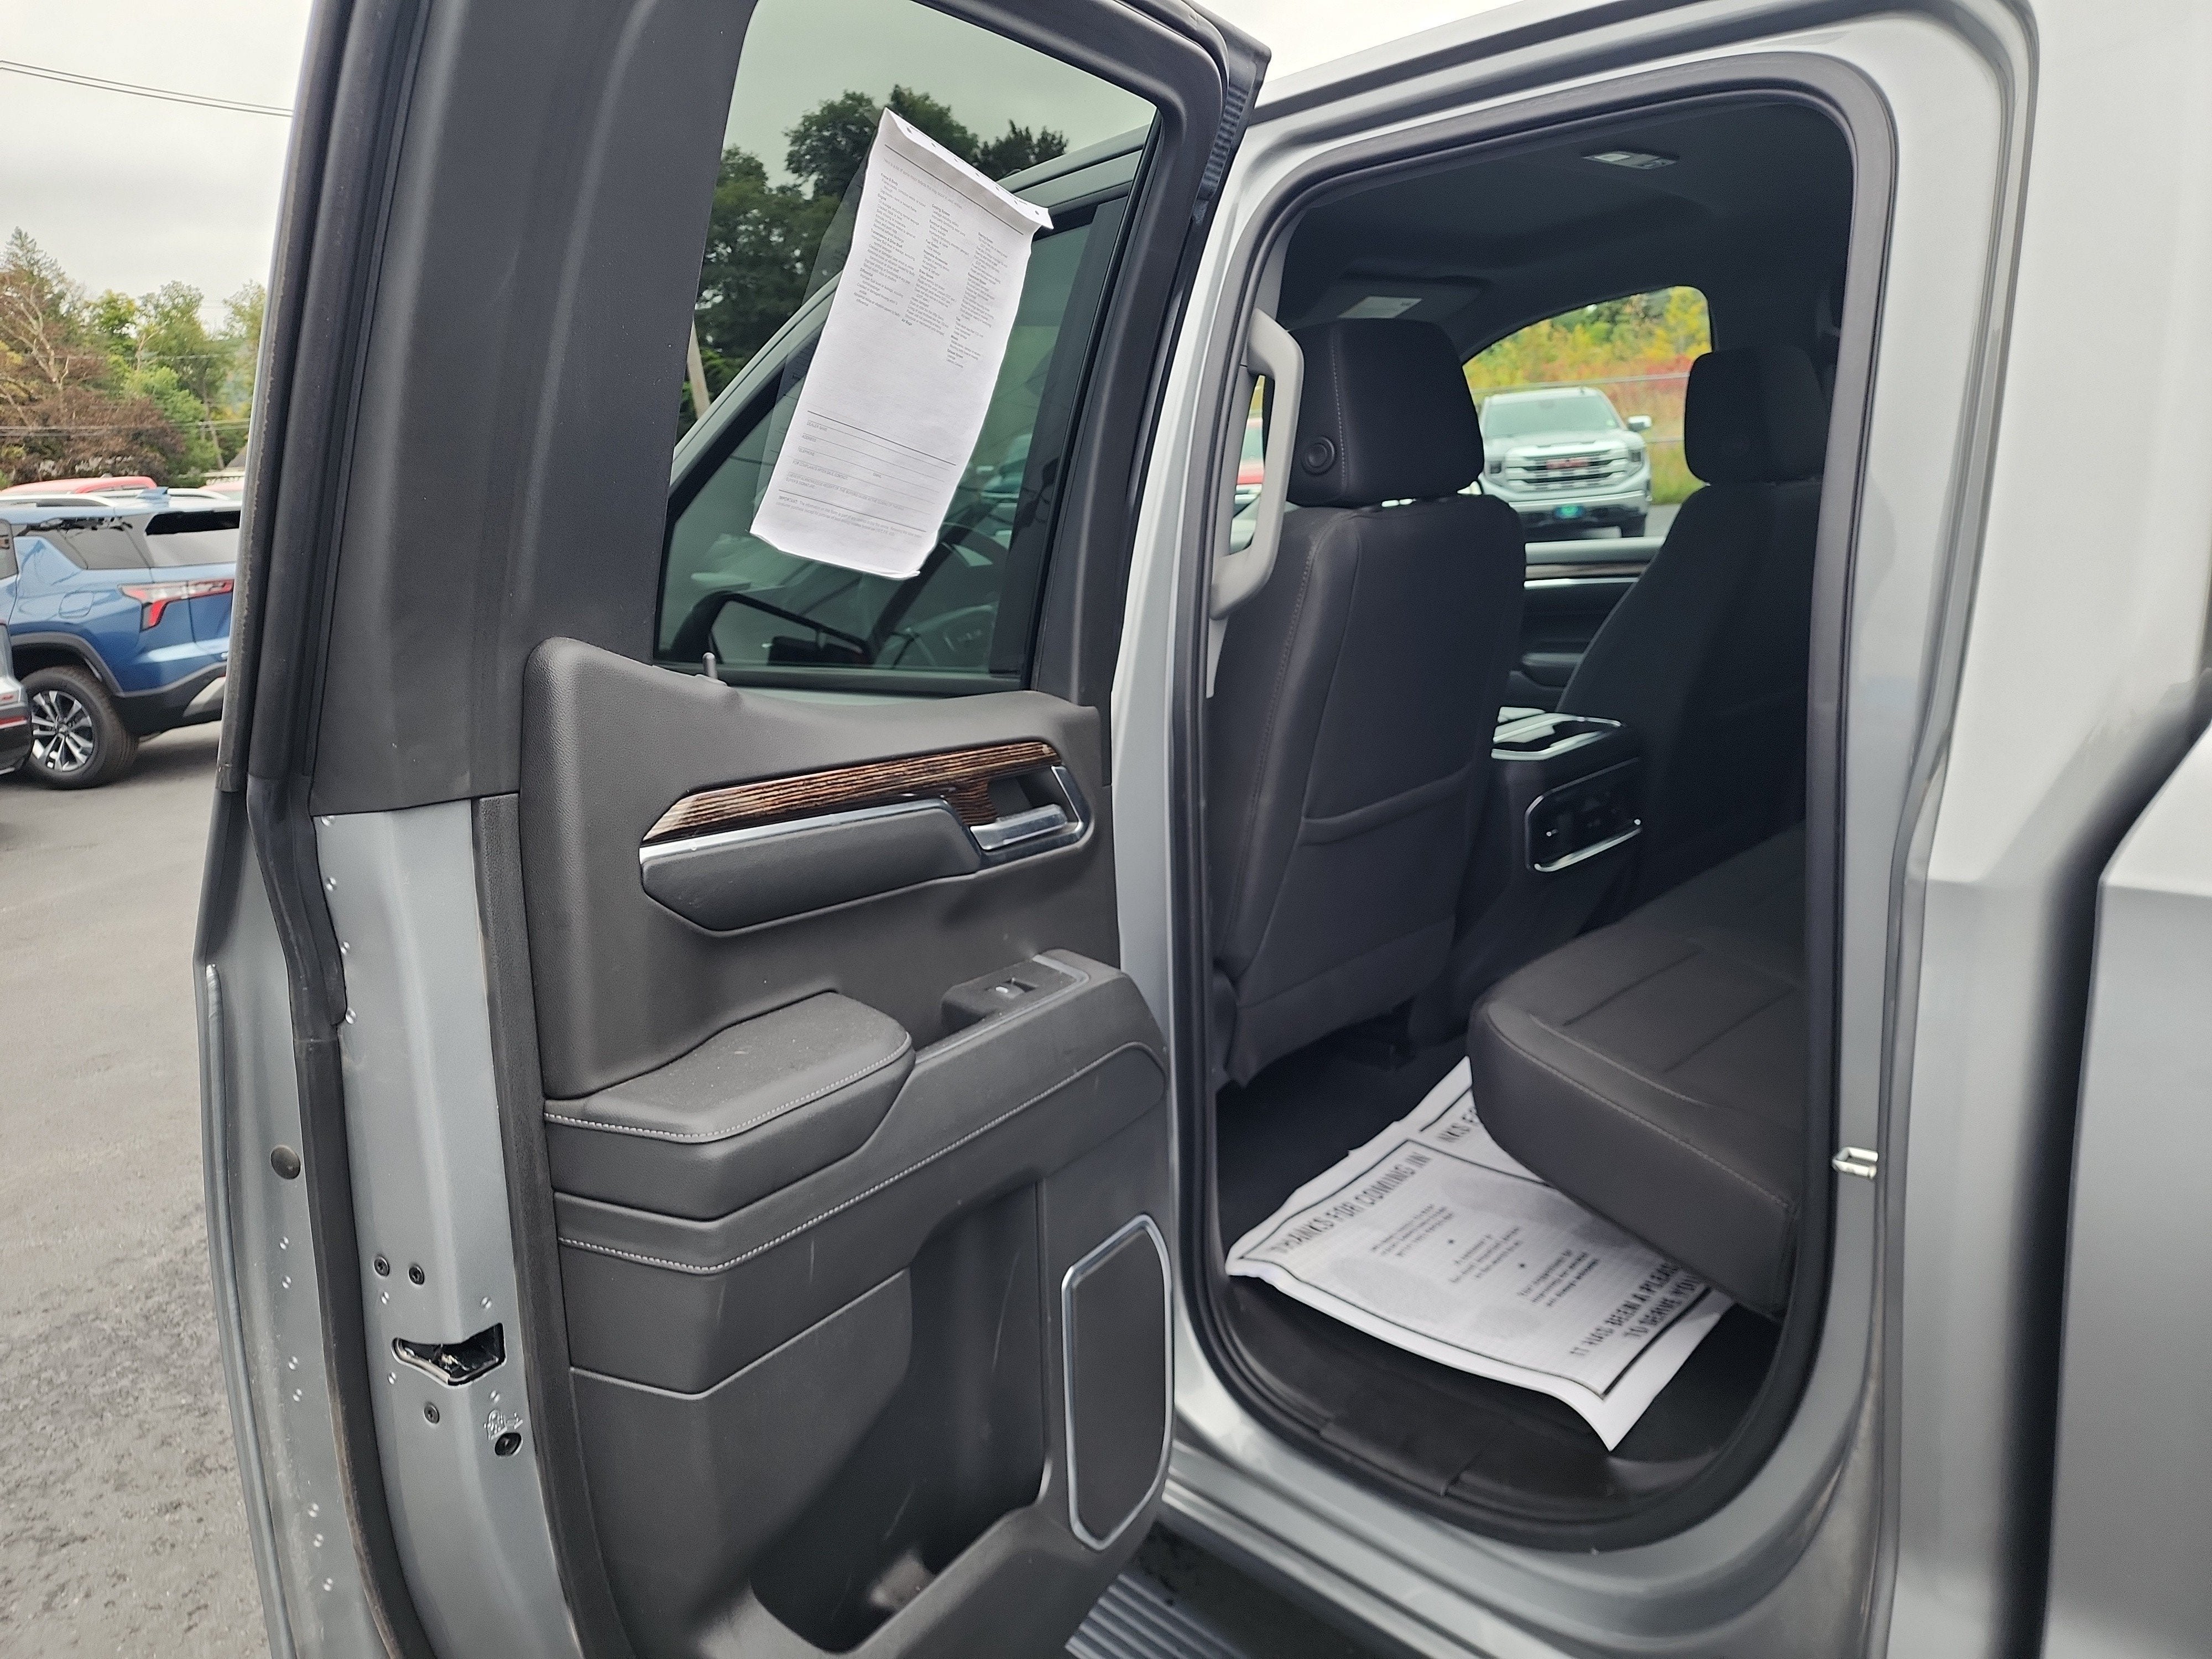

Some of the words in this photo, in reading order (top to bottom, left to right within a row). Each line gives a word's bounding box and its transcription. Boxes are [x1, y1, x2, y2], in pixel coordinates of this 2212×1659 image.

[1269, 1217, 1334, 1254] THANKS
[1327, 1201, 1364, 1221] FOR
[1355, 1164, 1416, 1205] COMING
[1406, 1152, 1432, 1168] IN
[1569, 1346, 1590, 1357] IT
[1581, 1326, 1615, 1345] HAS
[1605, 1300, 1642, 1326] BEEN
[1622, 1327, 1648, 1337] TO
[1638, 1297, 1682, 1326] SERVE
